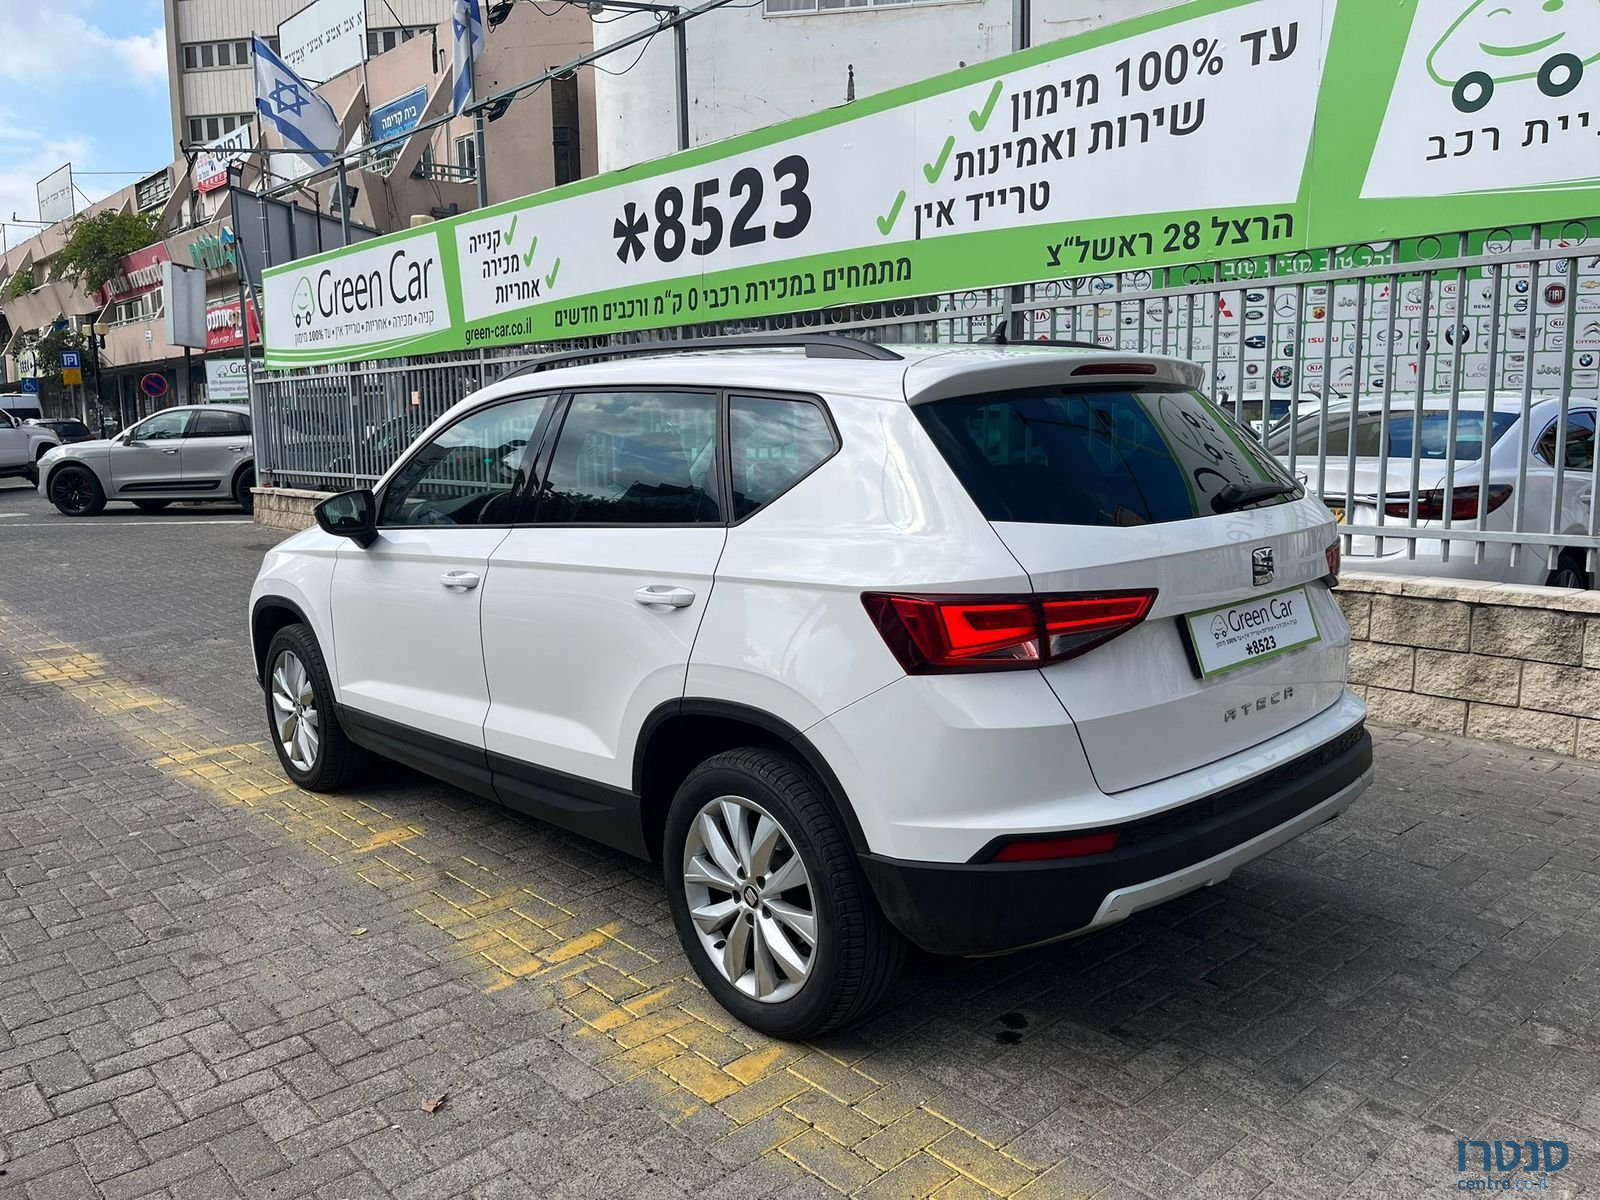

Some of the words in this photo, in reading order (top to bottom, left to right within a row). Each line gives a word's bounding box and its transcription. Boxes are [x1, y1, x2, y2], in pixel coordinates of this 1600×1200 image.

[1240, 21, 1298, 66] עד
[1116, 37, 1224, 97] 100%
[404, 106, 417, 120] בית
[1011, 73, 1099, 133] מימון
[382, 111, 403, 130] קדימה
[1088, 98, 1205, 155] שירות
[1521, 112, 1600, 147] יית
[953, 127, 1076, 182] ואמינות
[1426, 127, 1499, 160] רכב
[966, 181, 1050, 222] טרייד
[915, 198, 954, 240] אין
[1212, 212, 1294, 246] הרצל
[469, 230, 501, 254] קנייה
[1046, 232, 1152, 267] ראשל"צ
[1163, 220, 1200, 253] 28
[482, 254, 520, 279] מכירה
[823, 256, 912, 292] מתמחים
[317, 269, 383, 318] Green
[389, 250, 433, 304] Car
[495, 278, 540, 304] אחריות
[703, 284, 740, 309] רכבי
[745, 268, 816, 303] במכירת
[1549, 290, 1563, 300] FIAT
[603, 298, 648, 321] ורכבים
[654, 289, 682, 315] ק"מ
[688, 288, 698, 311] 0
[1404, 304, 1435, 312] TOYA
[345, 322, 361, 336] טרייד
[365, 318, 388, 333] אחריות
[392, 314, 413, 328] מכירה
[418, 310, 434, 326] קניה
[554, 305, 598, 327] חדשים
[309, 329, 324, 341] 100%
[465, 317, 532, 345] green-car.co.il
[1228, 607, 1270, 632] Green
[1269, 598, 1293, 620] Car
[1223, 686, 1295, 723] ATECA
